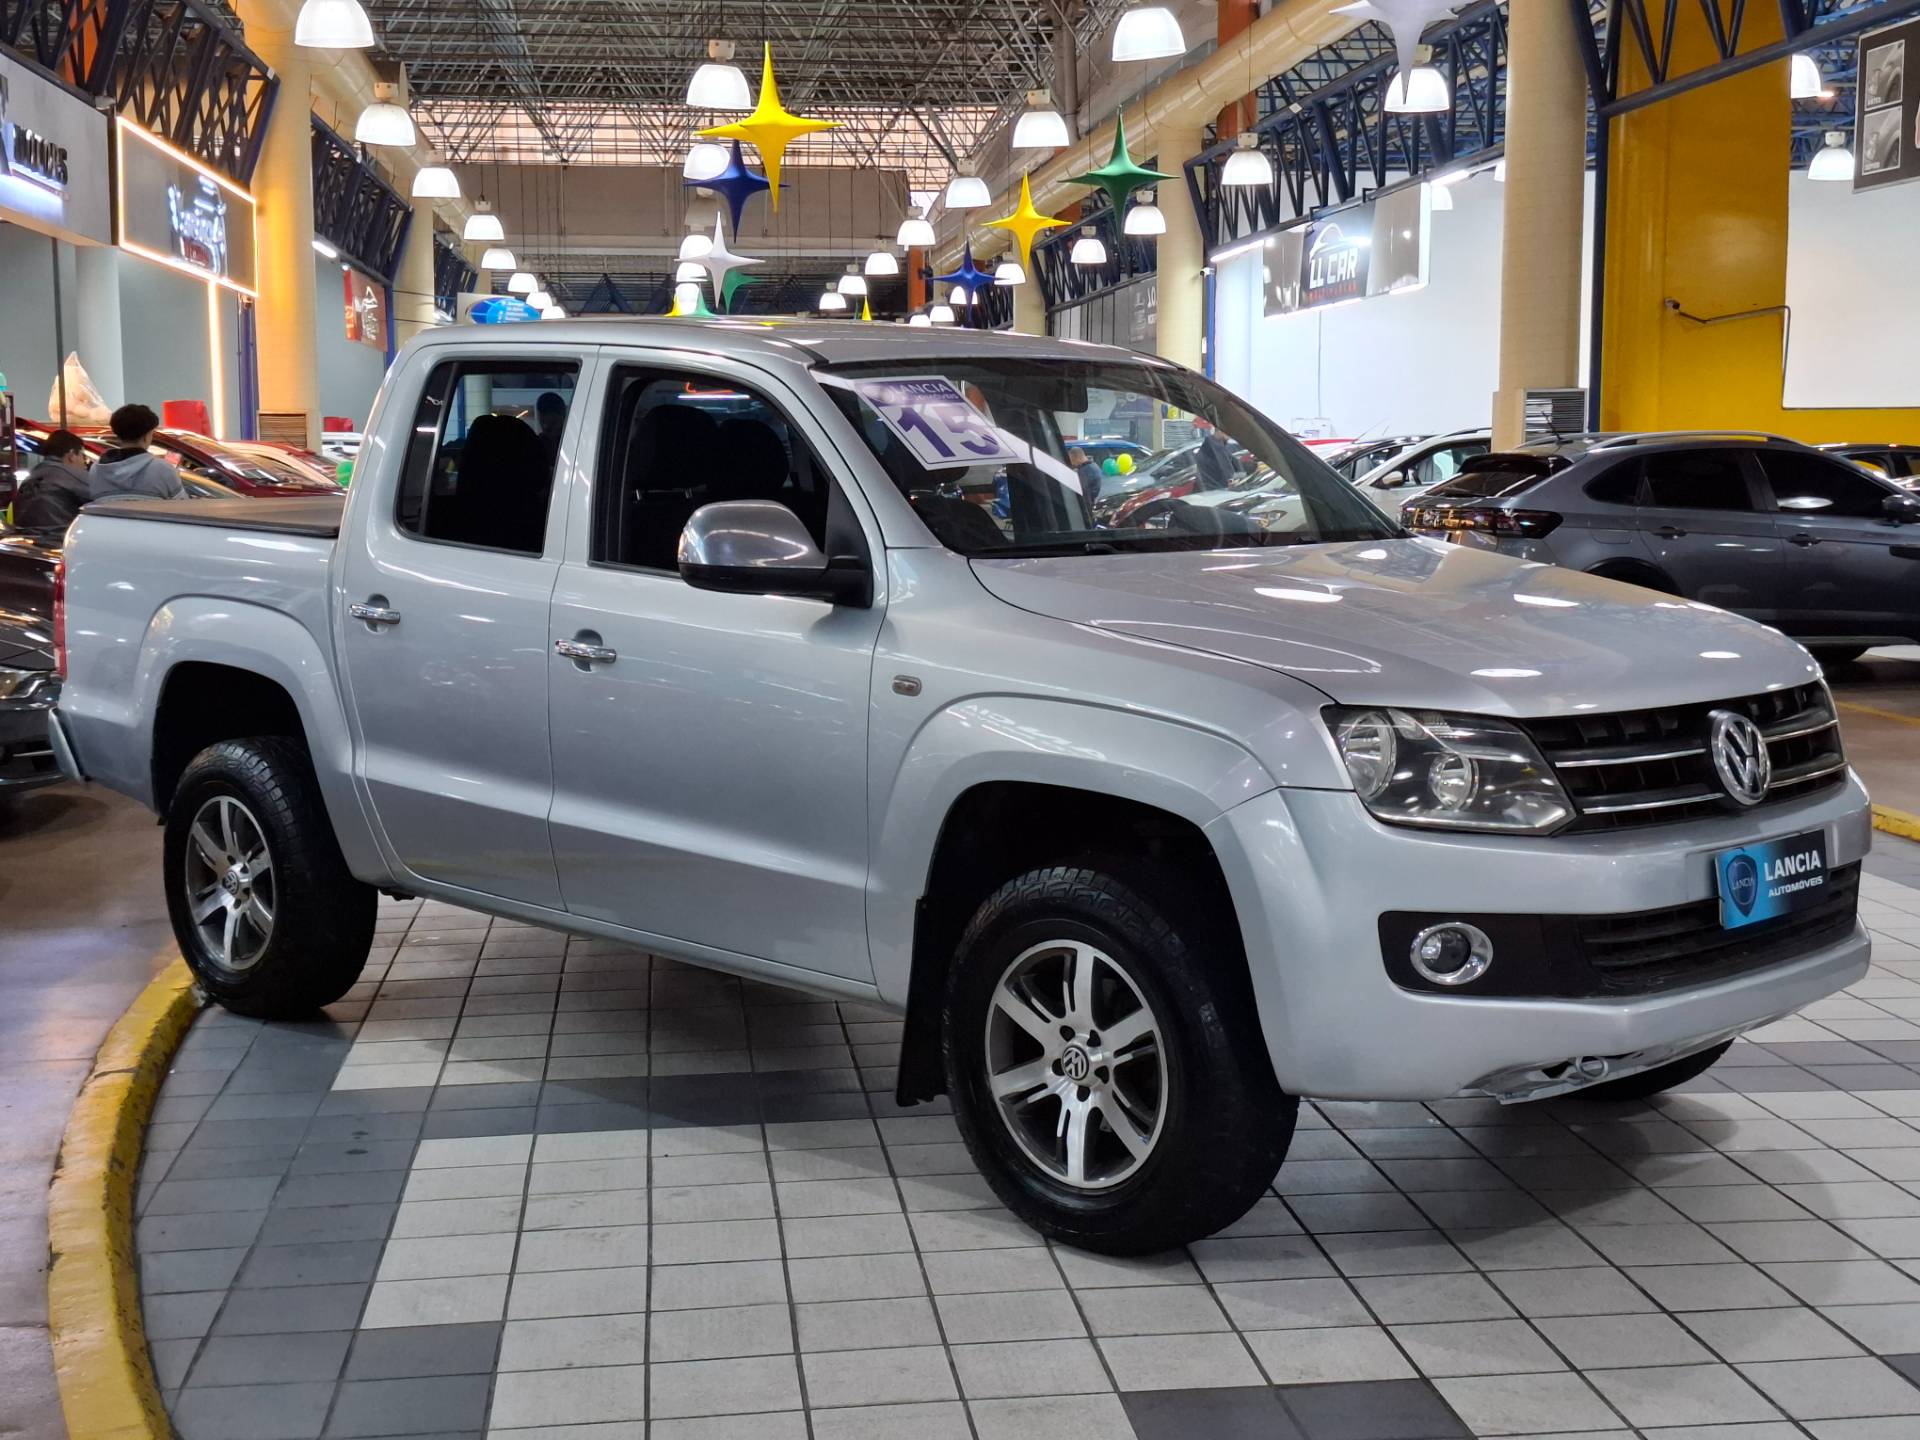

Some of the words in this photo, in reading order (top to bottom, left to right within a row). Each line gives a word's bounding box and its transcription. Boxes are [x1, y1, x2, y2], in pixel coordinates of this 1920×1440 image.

[1309, 257, 1324, 289] LL
[1327, 248, 1359, 285] CAR
[897, 405, 1000, 458] 15
[1764, 850, 1822, 882] LANCIA
